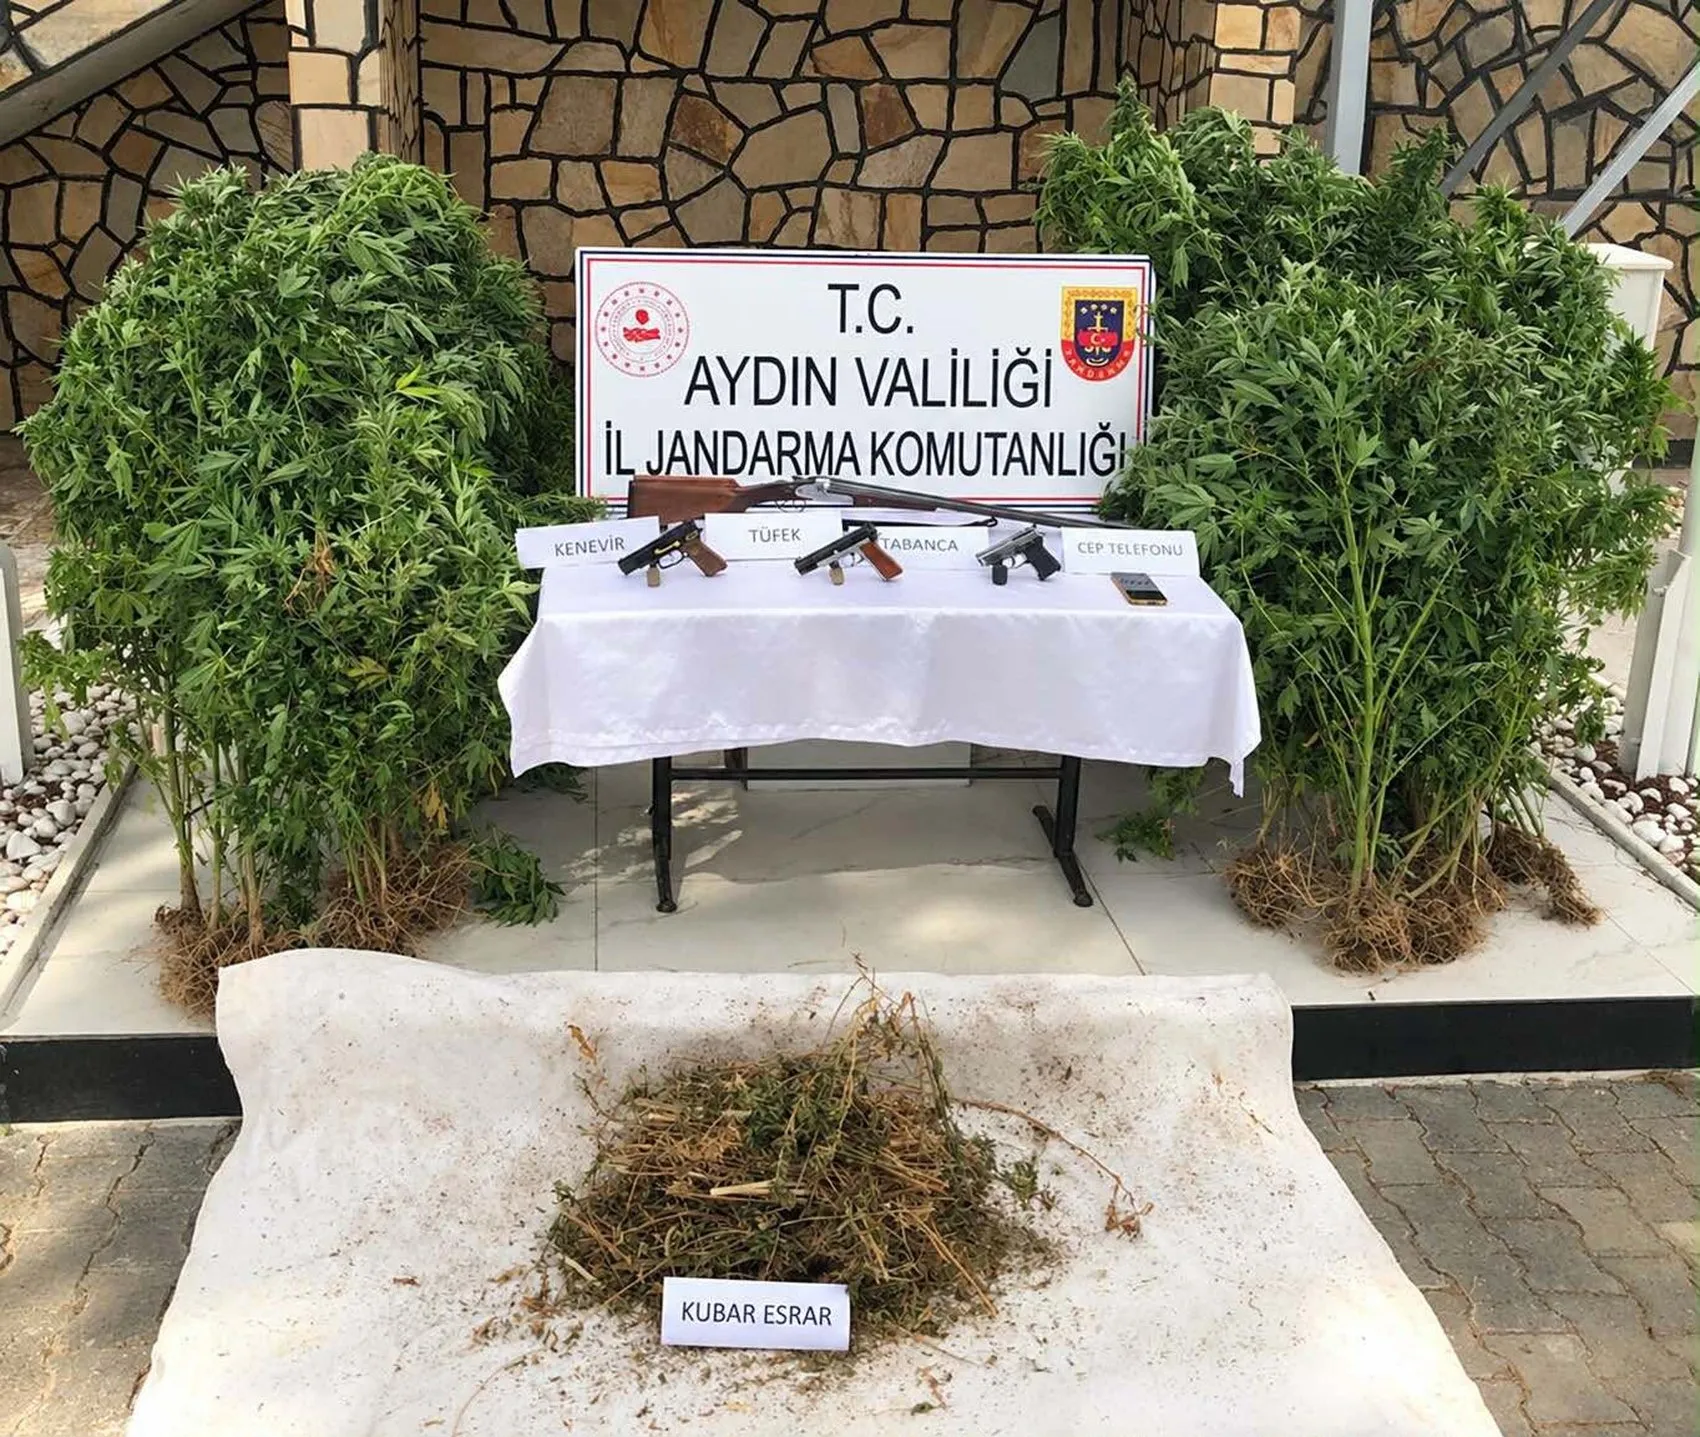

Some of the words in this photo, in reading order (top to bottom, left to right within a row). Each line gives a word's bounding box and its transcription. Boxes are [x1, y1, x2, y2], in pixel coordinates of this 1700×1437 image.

[827, 283, 914, 334] T.C.
[684, 355, 837, 406] AYDIN
[855, 347, 1052, 408] VALİLİĞİ
[605, 421, 635, 476] İL
[646, 430, 861, 476] JANDARMA
[871, 421, 1126, 477] KOMUTANLIĞI
[749, 526, 801, 543] TÜFEK
[880, 537, 959, 552] TABANCA
[554, 536, 625, 557] KENEVİR
[1077, 542, 1104, 554] CEP
[1109, 543, 1183, 556] TELEFONU
[682, 1301, 756, 1324] KUBAR
[763, 1305, 832, 1326] ESRAR
